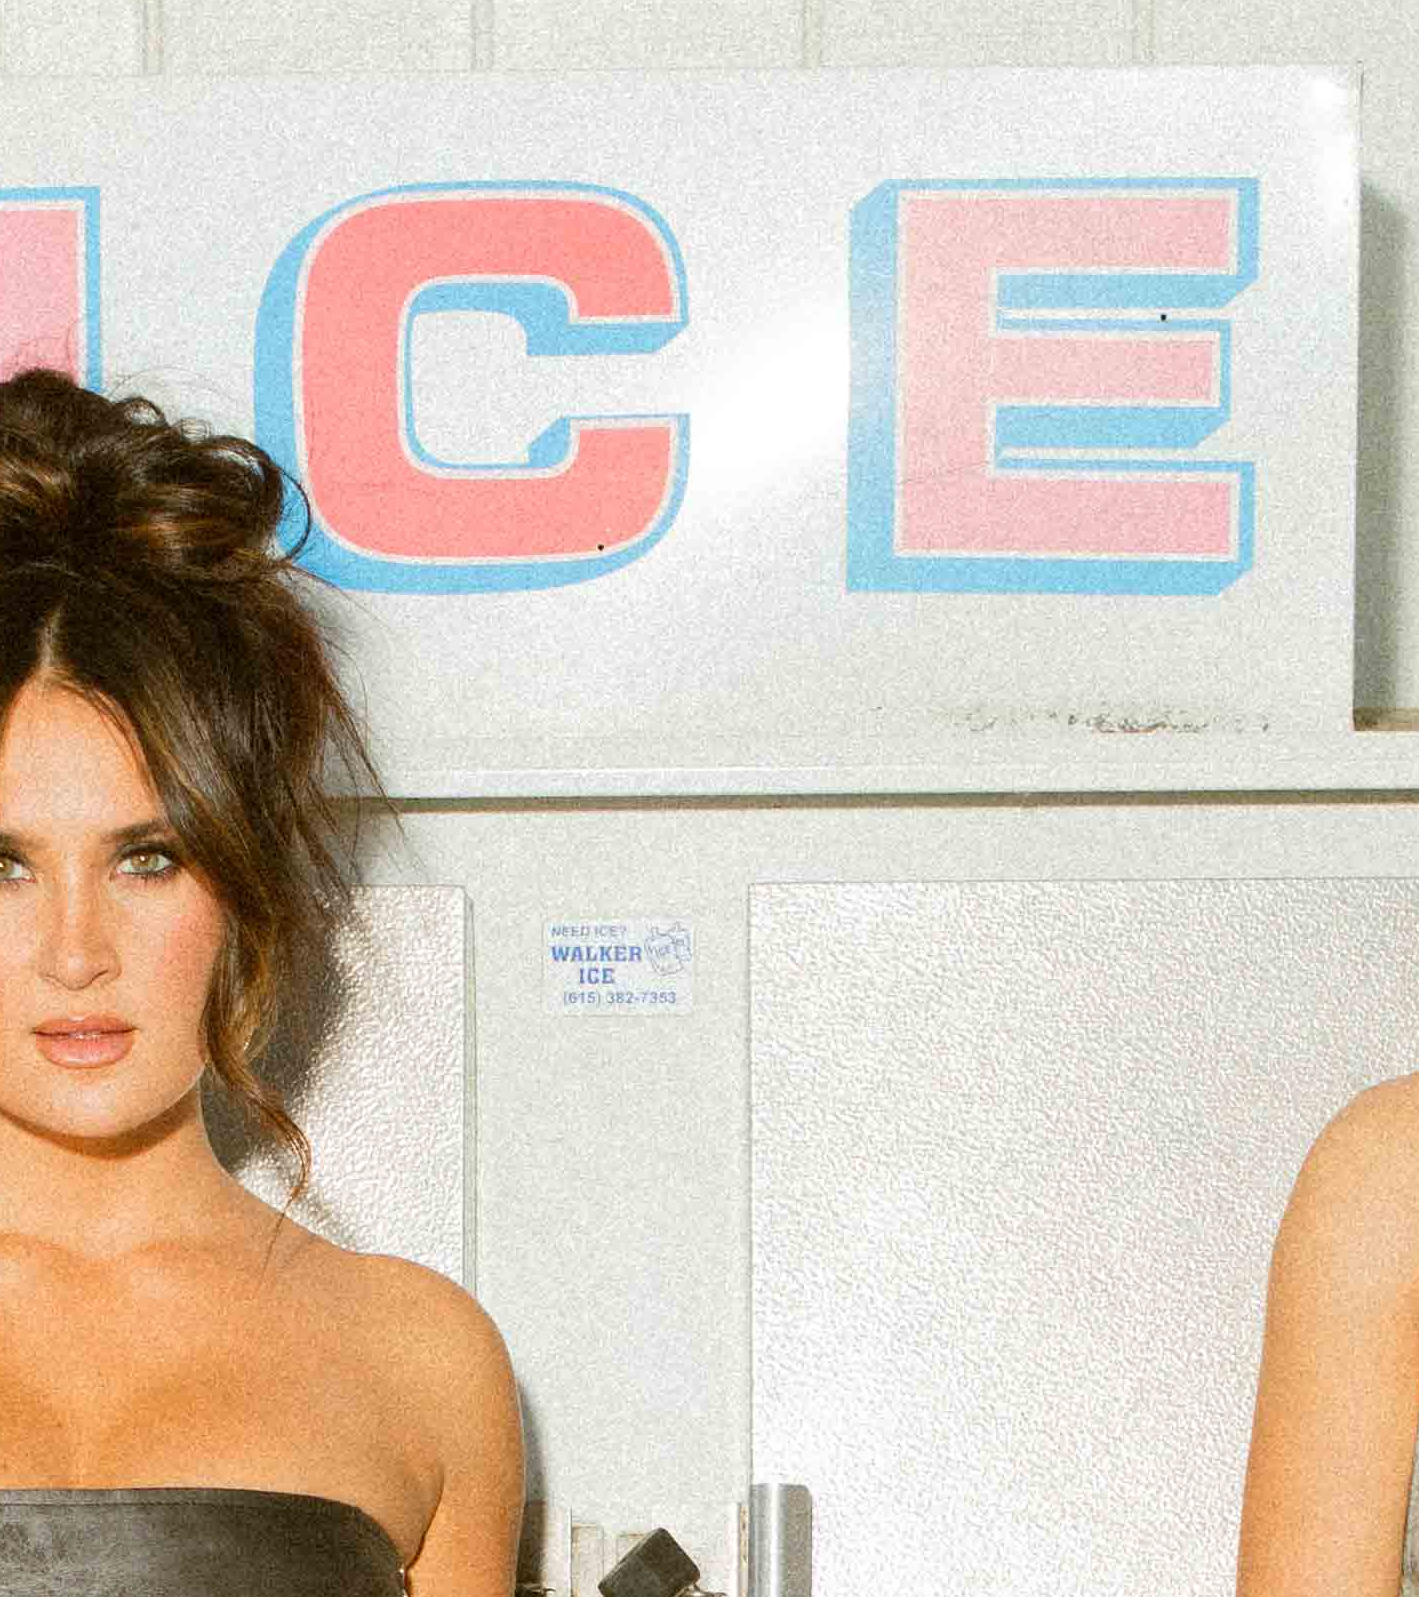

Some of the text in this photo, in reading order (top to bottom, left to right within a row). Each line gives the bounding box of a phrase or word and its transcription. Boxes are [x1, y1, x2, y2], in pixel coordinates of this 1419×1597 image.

[550, 924, 628, 937] NEED ICE?
[550, 945, 643, 962] WALKER
[579, 968, 615, 985] ICE
[563, 991, 601, 1005] (615)
